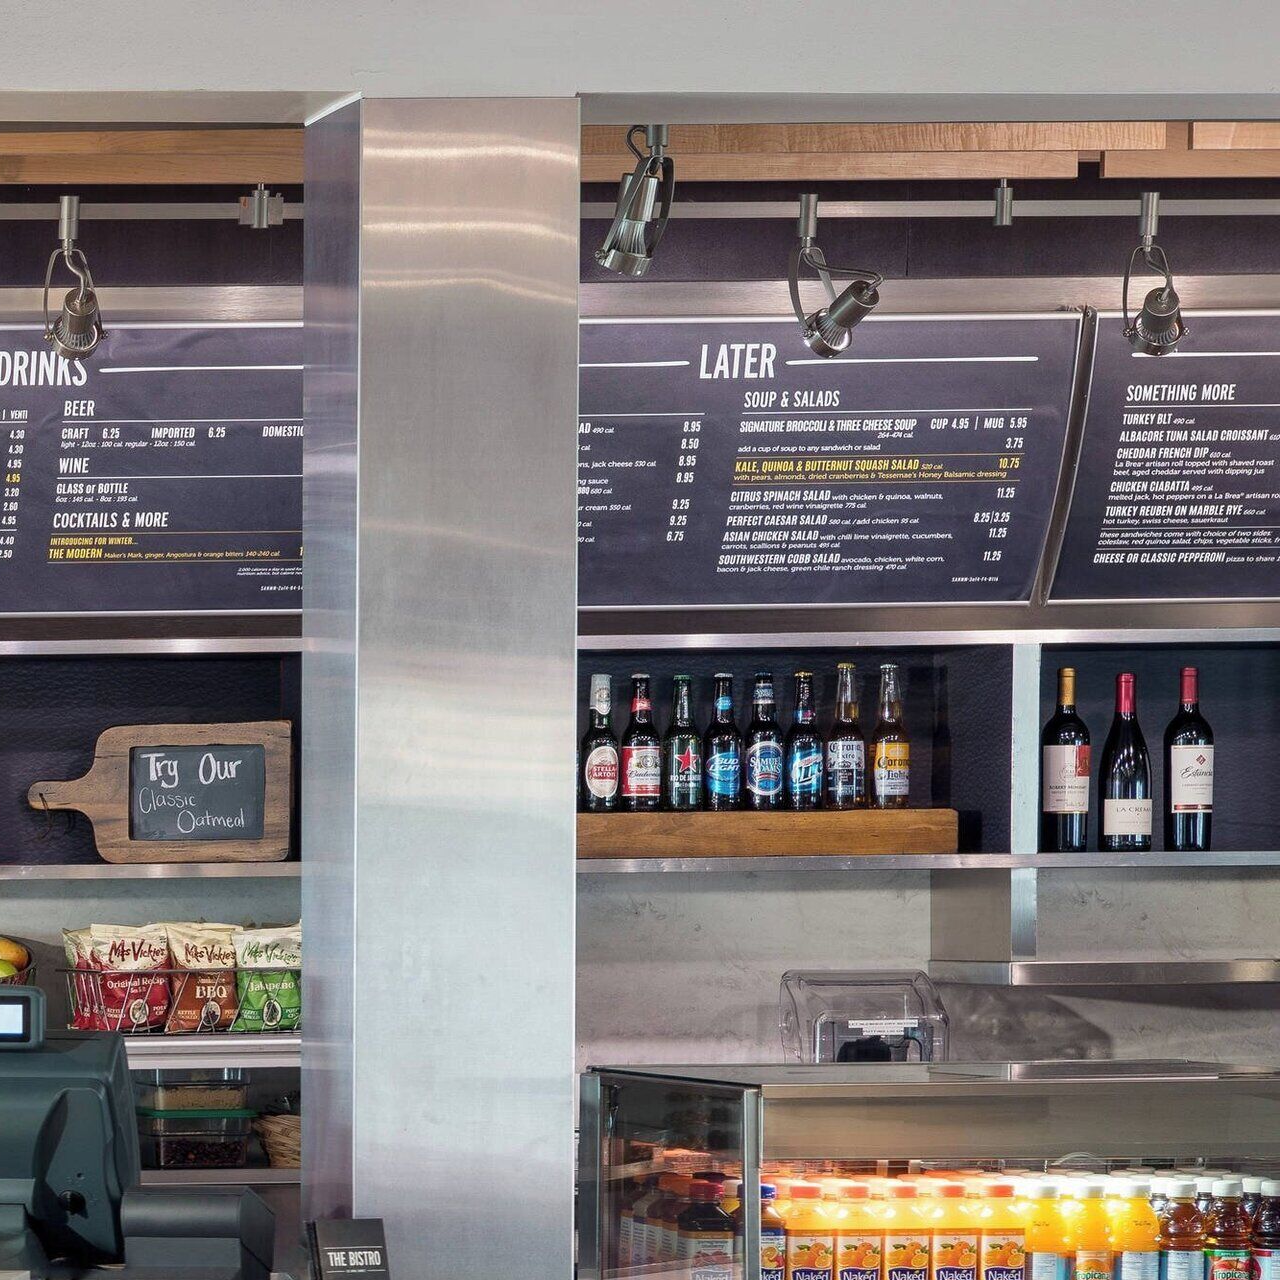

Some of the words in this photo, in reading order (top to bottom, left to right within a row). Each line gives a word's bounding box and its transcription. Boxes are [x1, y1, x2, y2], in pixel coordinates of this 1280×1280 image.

[700, 344, 776, 379] LATER
[744, 391, 776, 408] SOUP
[781, 391, 789, 407] &
[794, 391, 840, 407] SALADS
[1126, 384, 1197, 401] SOMETHING
[1202, 384, 1236, 400] MORE
[11, 410, 27, 419] VENTI
[64, 401, 95, 416] BEER
[931, 419, 947, 429] CUP
[952, 418, 969, 429] 4.95
[984, 418, 1004, 428] MUG
[1010, 417, 1027, 428] 5.95
[1123, 414, 1155, 425] TURKEY
[1157, 414, 1172, 424] BLT
[62, 428, 89, 439] CRAFT
[103, 428, 120, 439] 6.25
[151, 428, 195, 438] IMPORTED
[208, 427, 225, 438] 6.25
[59, 458, 89, 473] WINE
[736, 462, 759, 472] KALE,
[762, 461, 793, 471] QUINOA
[796, 461, 802, 471] &
[805, 461, 853, 471] BUTTERNUT
[855, 460, 889, 471] SQUASH
[892, 460, 919, 470] SALAD
[999, 458, 1020, 469] 10.75
[6, 474, 20, 483] 4.95
[53, 512, 117, 528] COCKTAILS
[122, 512, 129, 527] &
[135, 512, 168, 527] MORE
[49, 549, 64, 559] THE
[66, 549, 102, 558] MODERN
[716, 757, 739, 765] BUD
[141, 753, 178, 788] Try
[199, 753, 242, 784] Our
[140, 787, 196, 813] Classic
[177, 809, 244, 833] Oatmeal
[196, 986, 227, 998] BBQ
[327, 1252, 347, 1266] THE
[349, 1251, 381, 1265] BISTRO
[1075, 1272, 1110, 1280] Tropicana
[1214, 1271, 1249, 1280] Tropicana
